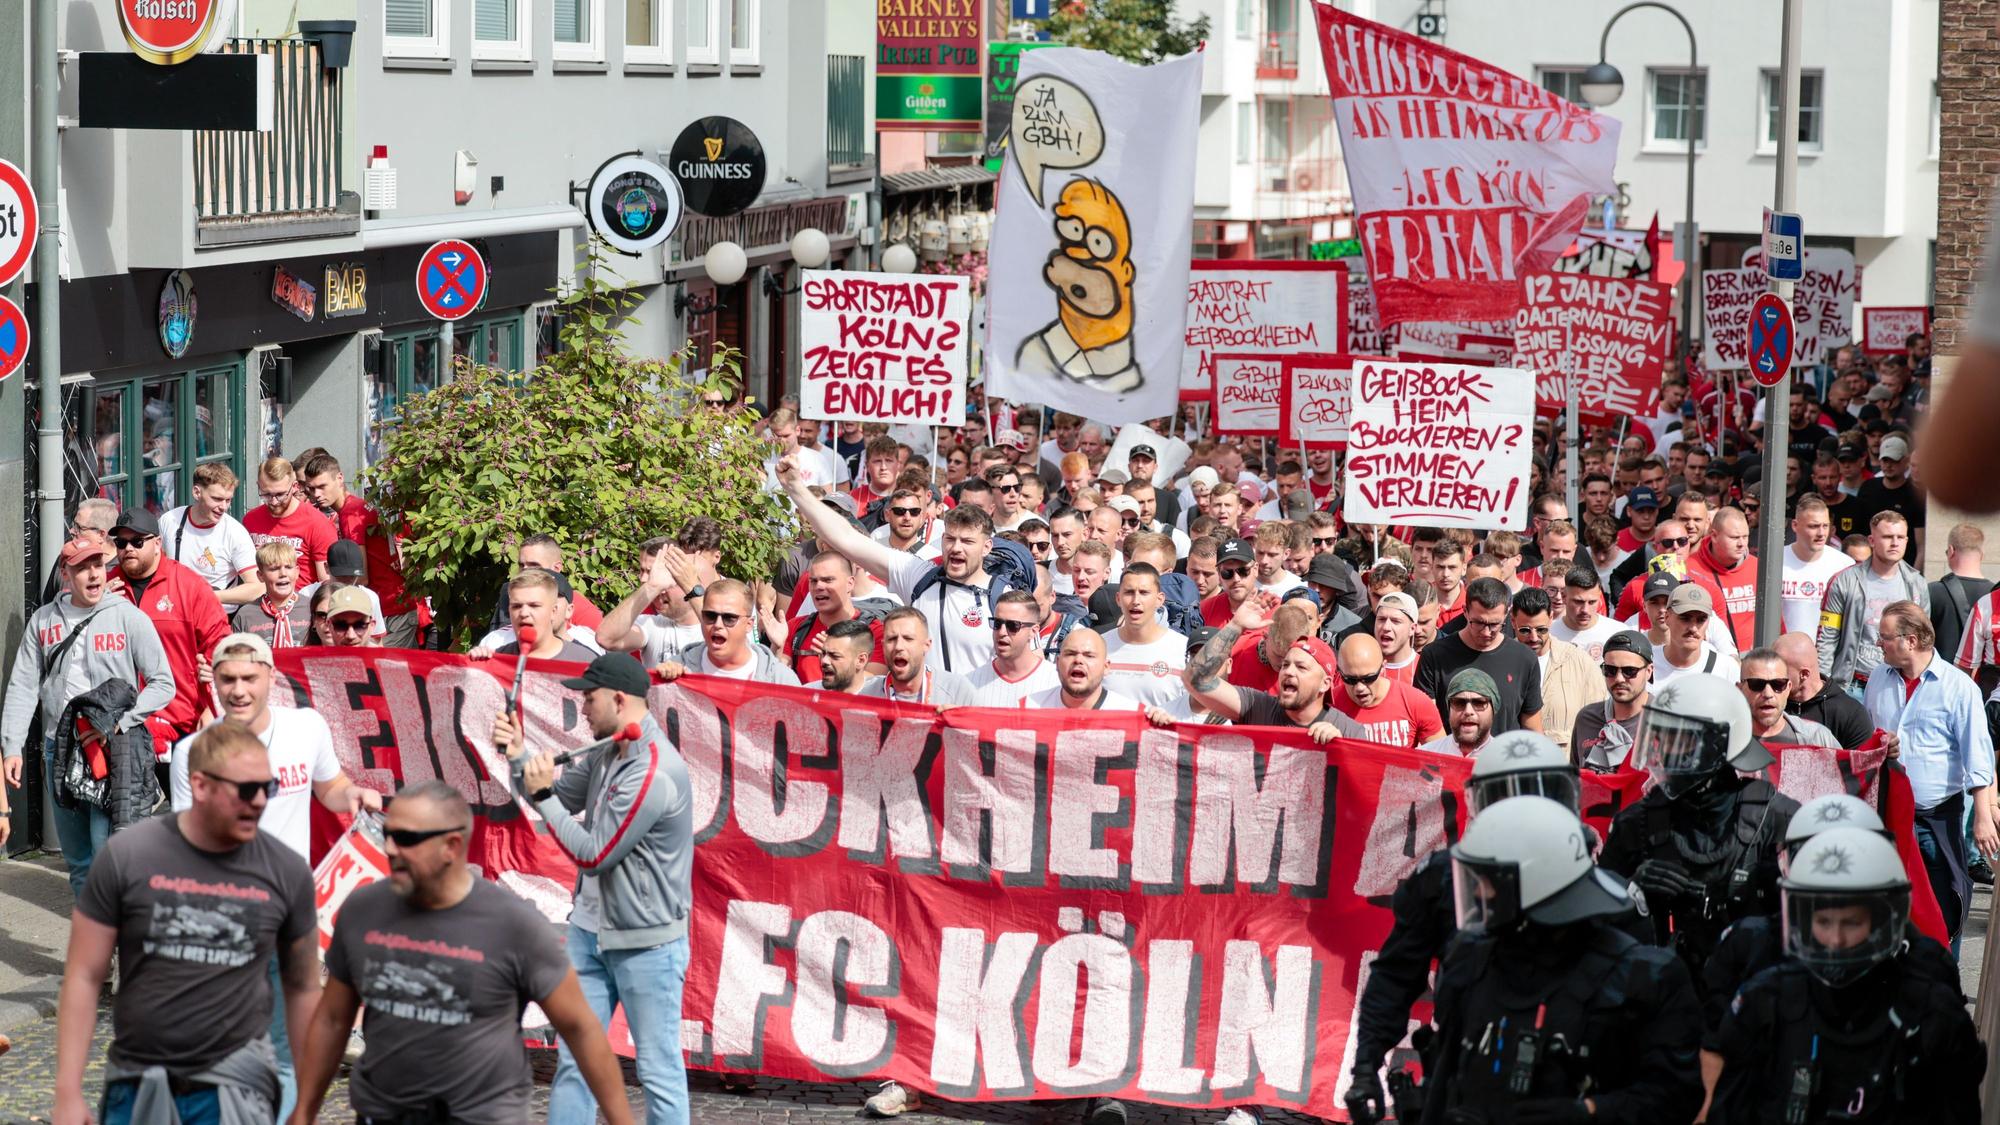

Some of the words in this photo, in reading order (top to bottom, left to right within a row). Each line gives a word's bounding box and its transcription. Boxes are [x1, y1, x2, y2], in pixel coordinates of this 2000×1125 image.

[877, 0, 974, 17] BARNEY
[878, 19, 978, 38] VALLELY'S
[937, 43, 978, 65] PUB
[678, 159, 752, 179] GUINNESS
[327, 267, 366, 312] BAR
[1705, 273, 1740, 292] DER
[804, 278, 959, 320] SPORTSTADT
[1525, 275, 1555, 306] 12
[1558, 275, 1662, 320] JAHRE
[1185, 322, 1318, 350] EIßBOCKHEIM
[1514, 330, 1563, 352] EINE
[804, 345, 902, 380] ZEIGT
[906, 354, 953, 385] ES
[824, 381, 953, 423] ENDLICH!
[1393, 396, 1471, 426] HEIM
[1348, 452, 1485, 480] STIMMEN
[1359, 477, 1520, 524] VERLIEREN!
[94, 633, 125, 651] RAS
[279, 763, 308, 789] RAS
[929, 906, 1313, 1095] KÖLN
